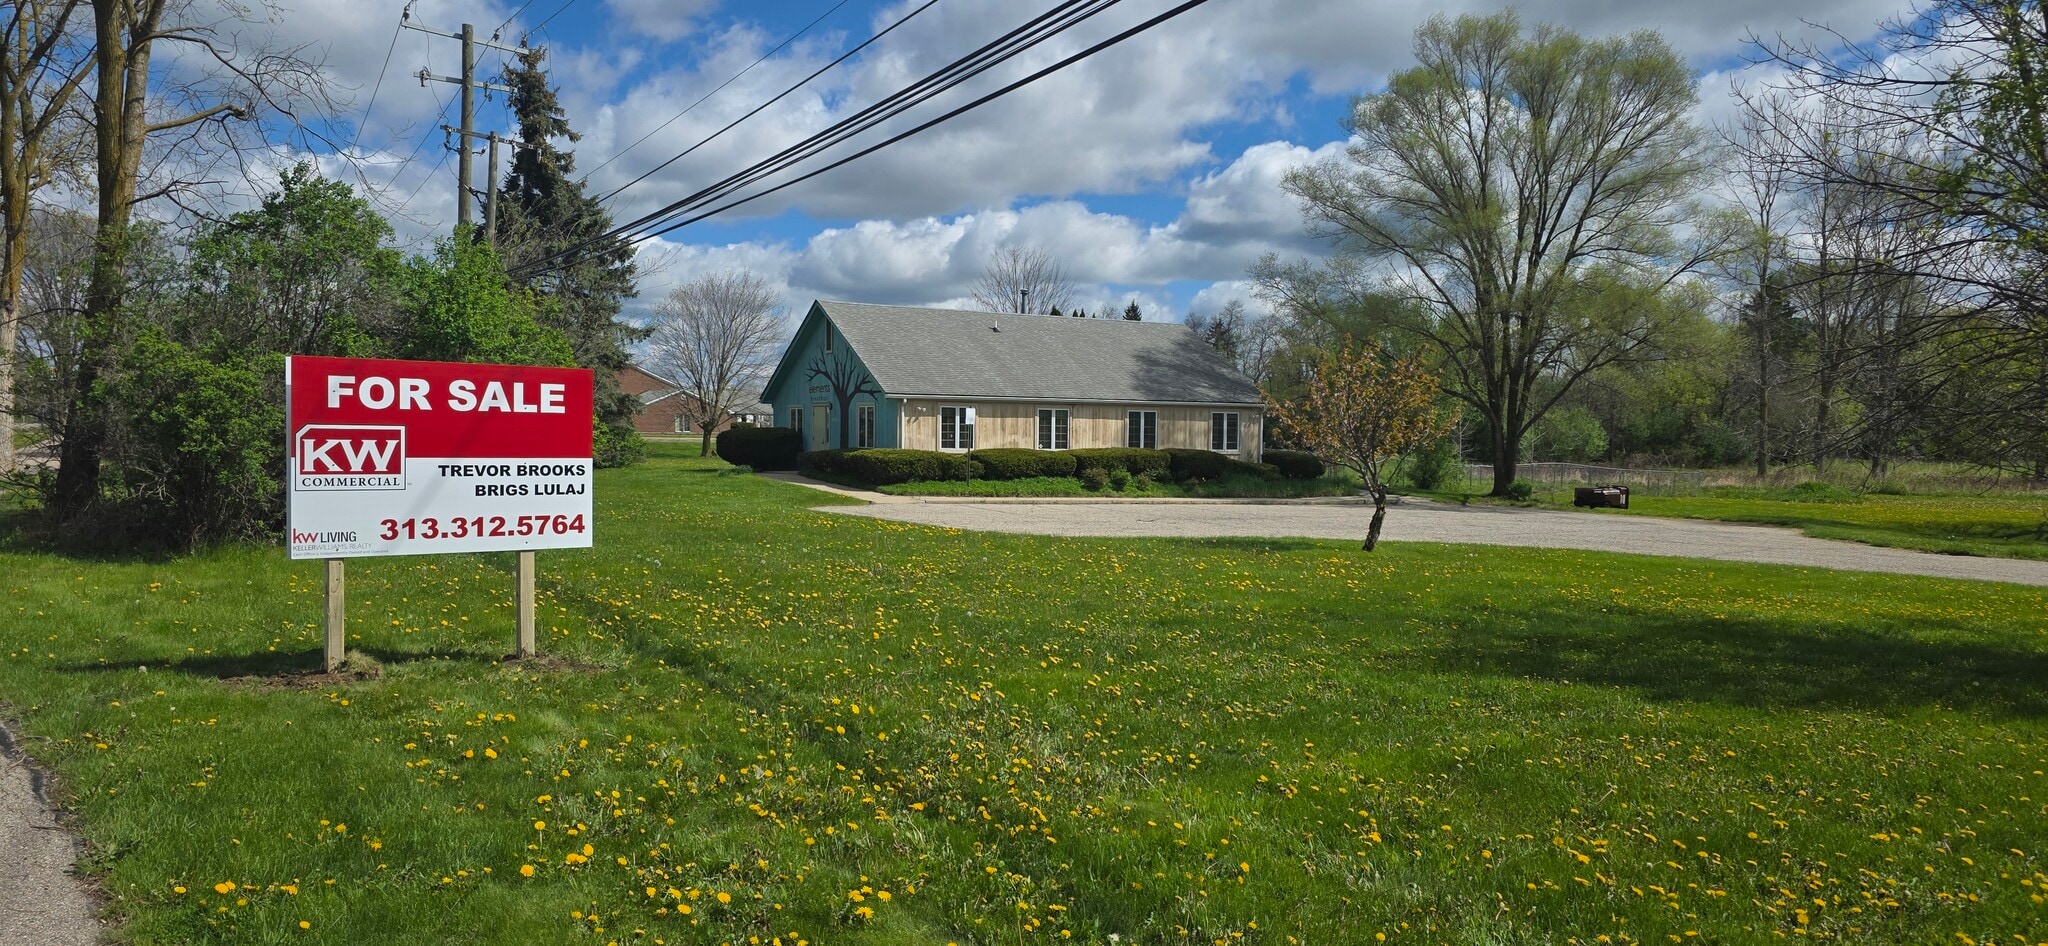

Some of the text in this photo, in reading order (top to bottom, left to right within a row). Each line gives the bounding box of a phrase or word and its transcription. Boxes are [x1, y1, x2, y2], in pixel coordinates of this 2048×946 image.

[327, 375, 566, 414] FOR SALE
[302, 438, 400, 472] KW
[438, 464, 586, 477] TREVOR BROOKS
[302, 477, 400, 487] COMMERCIAL
[475, 483, 585, 497] BRIGS LULAJ
[379, 513, 586, 541] 313.312.5764
[293, 528, 357, 543] kw LIVING
